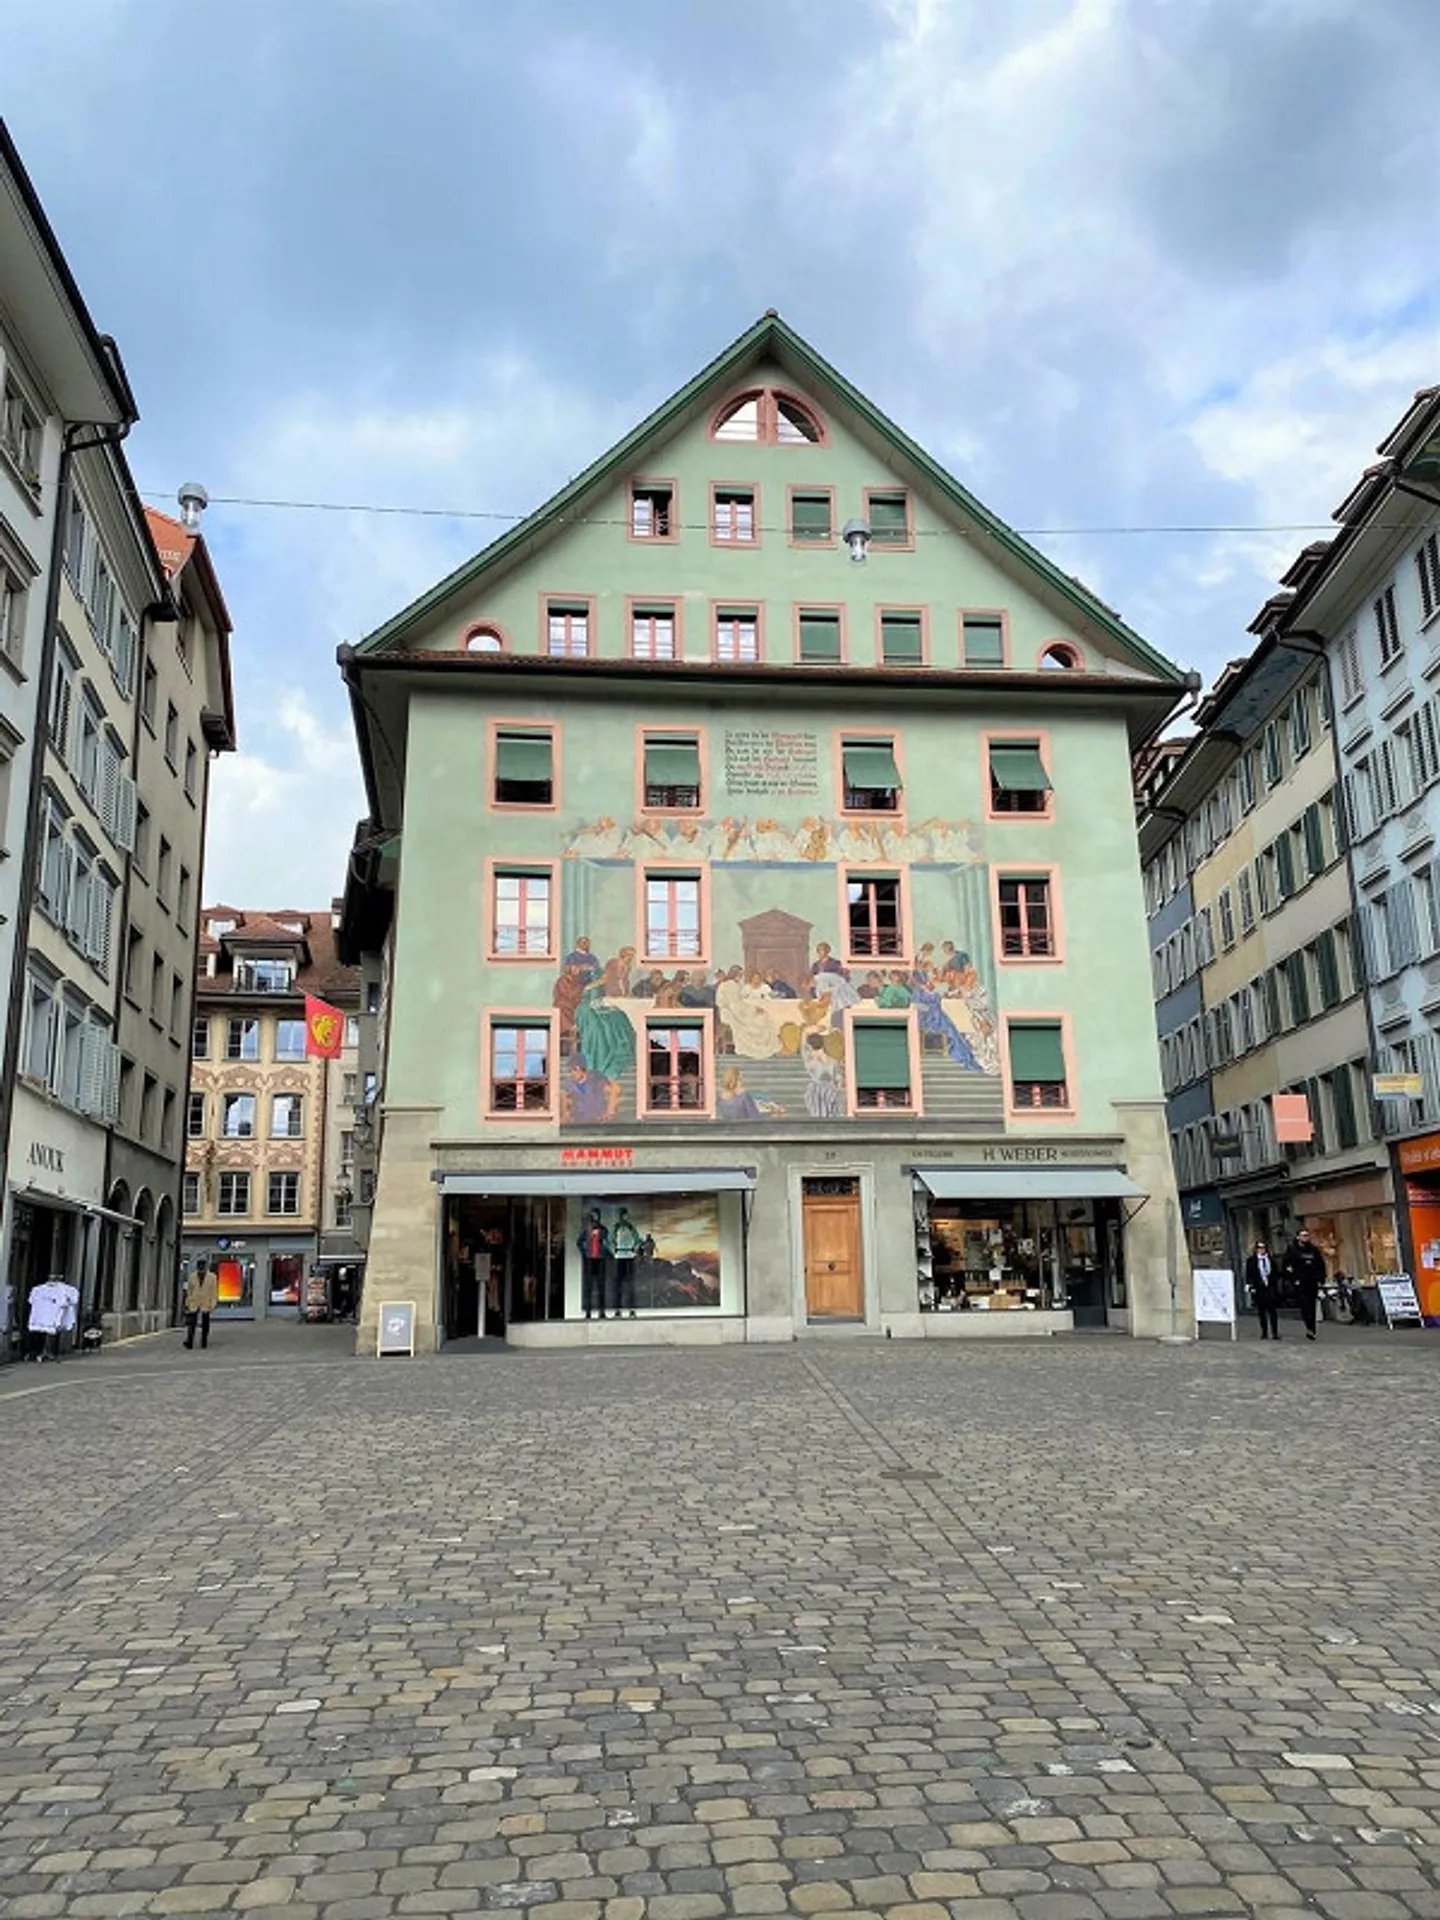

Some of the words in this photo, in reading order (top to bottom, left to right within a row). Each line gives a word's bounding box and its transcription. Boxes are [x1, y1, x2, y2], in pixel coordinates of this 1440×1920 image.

[26, 1141, 66, 1173] ANOUK
[562, 1148, 634, 1159] MAMMUT
[1000, 1147, 1058, 1161] WEBER
